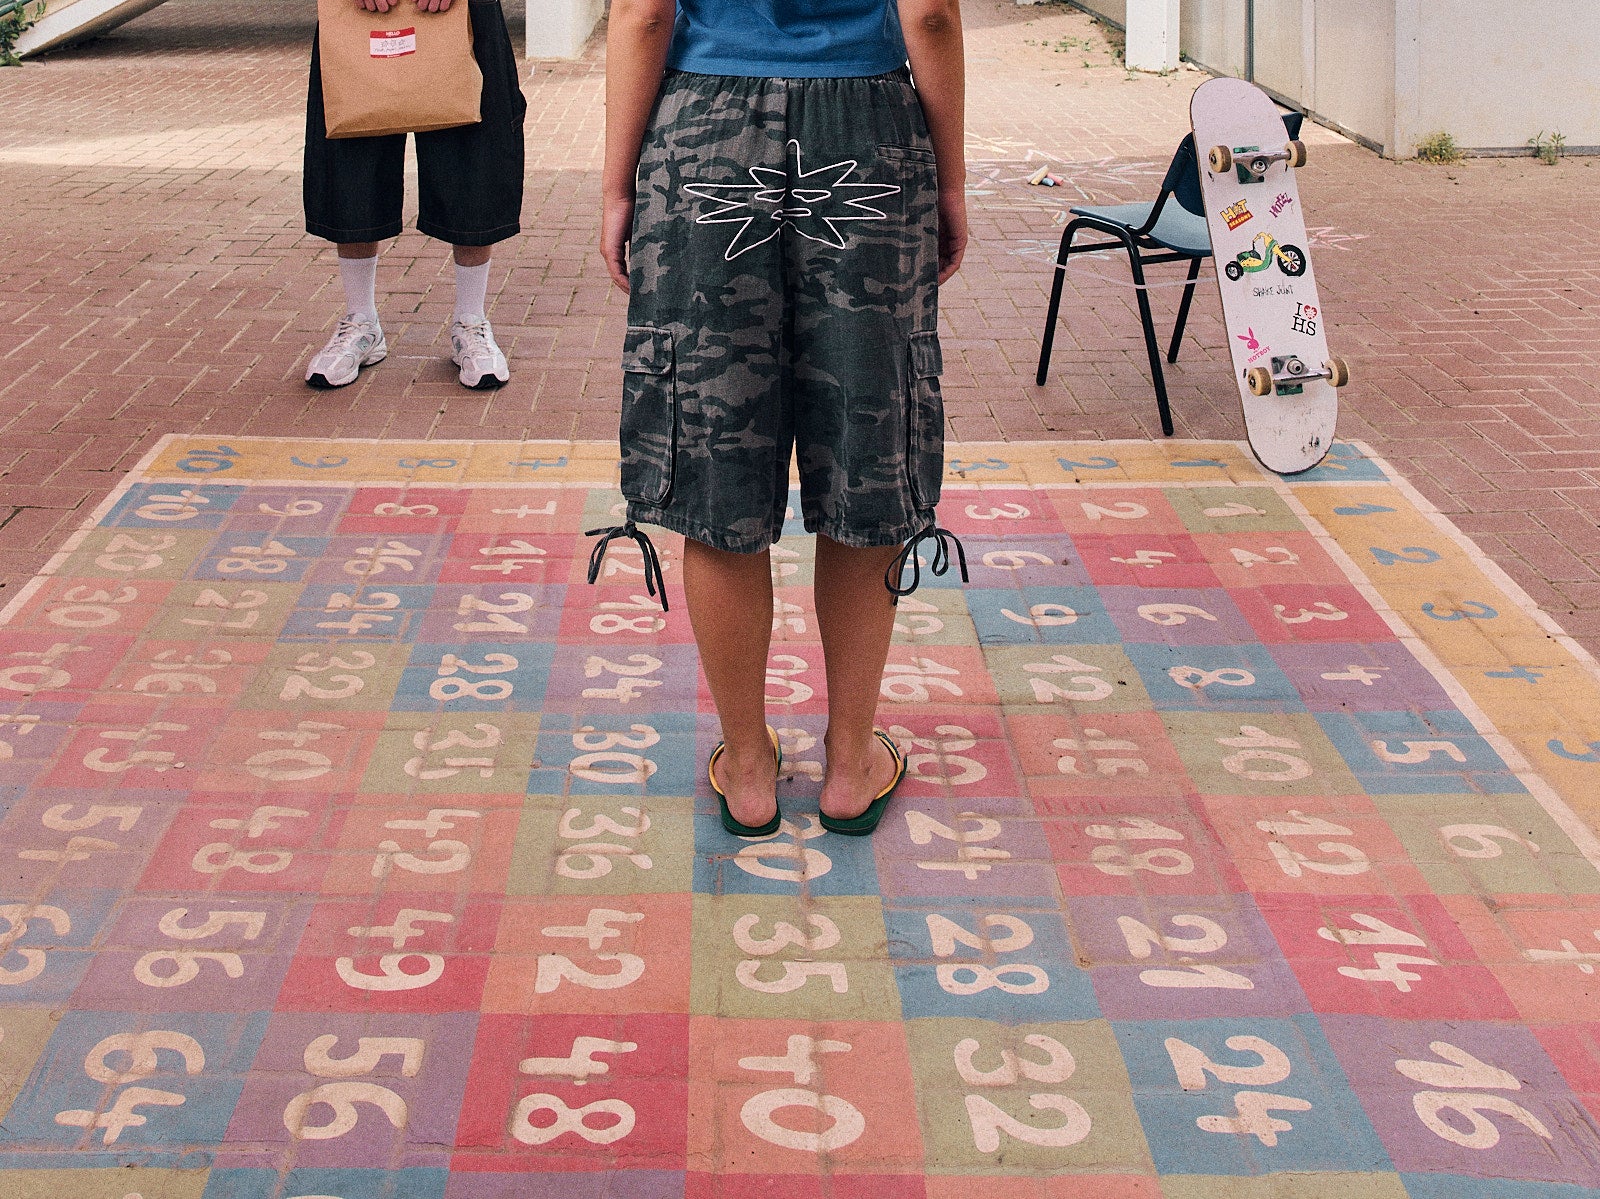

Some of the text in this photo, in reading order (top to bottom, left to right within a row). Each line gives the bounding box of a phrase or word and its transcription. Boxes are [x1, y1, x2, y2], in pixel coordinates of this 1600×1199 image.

[1291, 316, 1316, 336] HS
[1295, 302, 1303, 316] I
[176, 445, 242, 473] 10
[1056, 456, 1118, 472] 2
[136, 489, 209, 522] 10
[258, 499, 322, 516] 9
[964, 503, 1031, 520] 3
[1080, 501, 1149, 520] 2
[1203, 502, 1267, 518] 1
[1333, 503, 1396, 516] 1
[94, 533, 177, 572] 20
[216, 540, 297, 574] 18
[344, 540, 423, 576] 16
[470, 539, 548, 576] 14
[982, 550, 1054, 570] 6
[1110, 549, 1177, 569] 4
[1230, 546, 1299, 568] 2
[1369, 546, 1441, 566] 2
[45, 584, 138, 628] 30
[316, 591, 401, 635] 24
[453, 592, 535, 634] 21
[589, 595, 668, 634] 18
[1000, 603, 1079, 626] 9
[1138, 603, 1218, 626] 6
[1273, 602, 1349, 624] 3
[1421, 600, 1499, 622] 3
[133, 649, 232, 697] 36
[279, 650, 376, 699] 32
[429, 653, 519, 701] 28
[582, 653, 663, 705] 24
[880, 657, 963, 702] 16
[1023, 655, 1113, 703] 12
[1169, 665, 1255, 690] 8
[1320, 664, 1390, 686] 4
[1484, 664, 1552, 685] 4
[245, 720, 345, 782] 40
[403, 722, 501, 782] 35
[568, 723, 661, 784] 30
[888, 725, 987, 786] 20
[1215, 725, 1313, 782] 10
[1371, 739, 1466, 764] 5
[18, 802, 143, 862] 54
[191, 806, 310, 874] 48
[371, 808, 480, 877] 42
[555, 806, 653, 879] 36
[905, 810, 1012, 879] 24
[1084, 817, 1194, 876] 18
[1256, 809, 1371, 877] 12
[1439, 823, 1540, 859] 6
[133, 907, 266, 988] 56
[334, 908, 453, 991] 49
[534, 908, 646, 993] 42
[732, 913, 849, 993] 35
[925, 913, 1049, 995] 28
[1116, 914, 1255, 990] 21
[1316, 913, 1438, 993] 14
[54, 1030, 206, 1146] 64
[283, 1033, 426, 1140] 56
[512, 1035, 638, 1145] 48
[737, 1033, 866, 1152] 40
[953, 1034, 1092, 1153] 32
[1164, 1034, 1313, 1147] 24
[1394, 1040, 1554, 1150] 16
